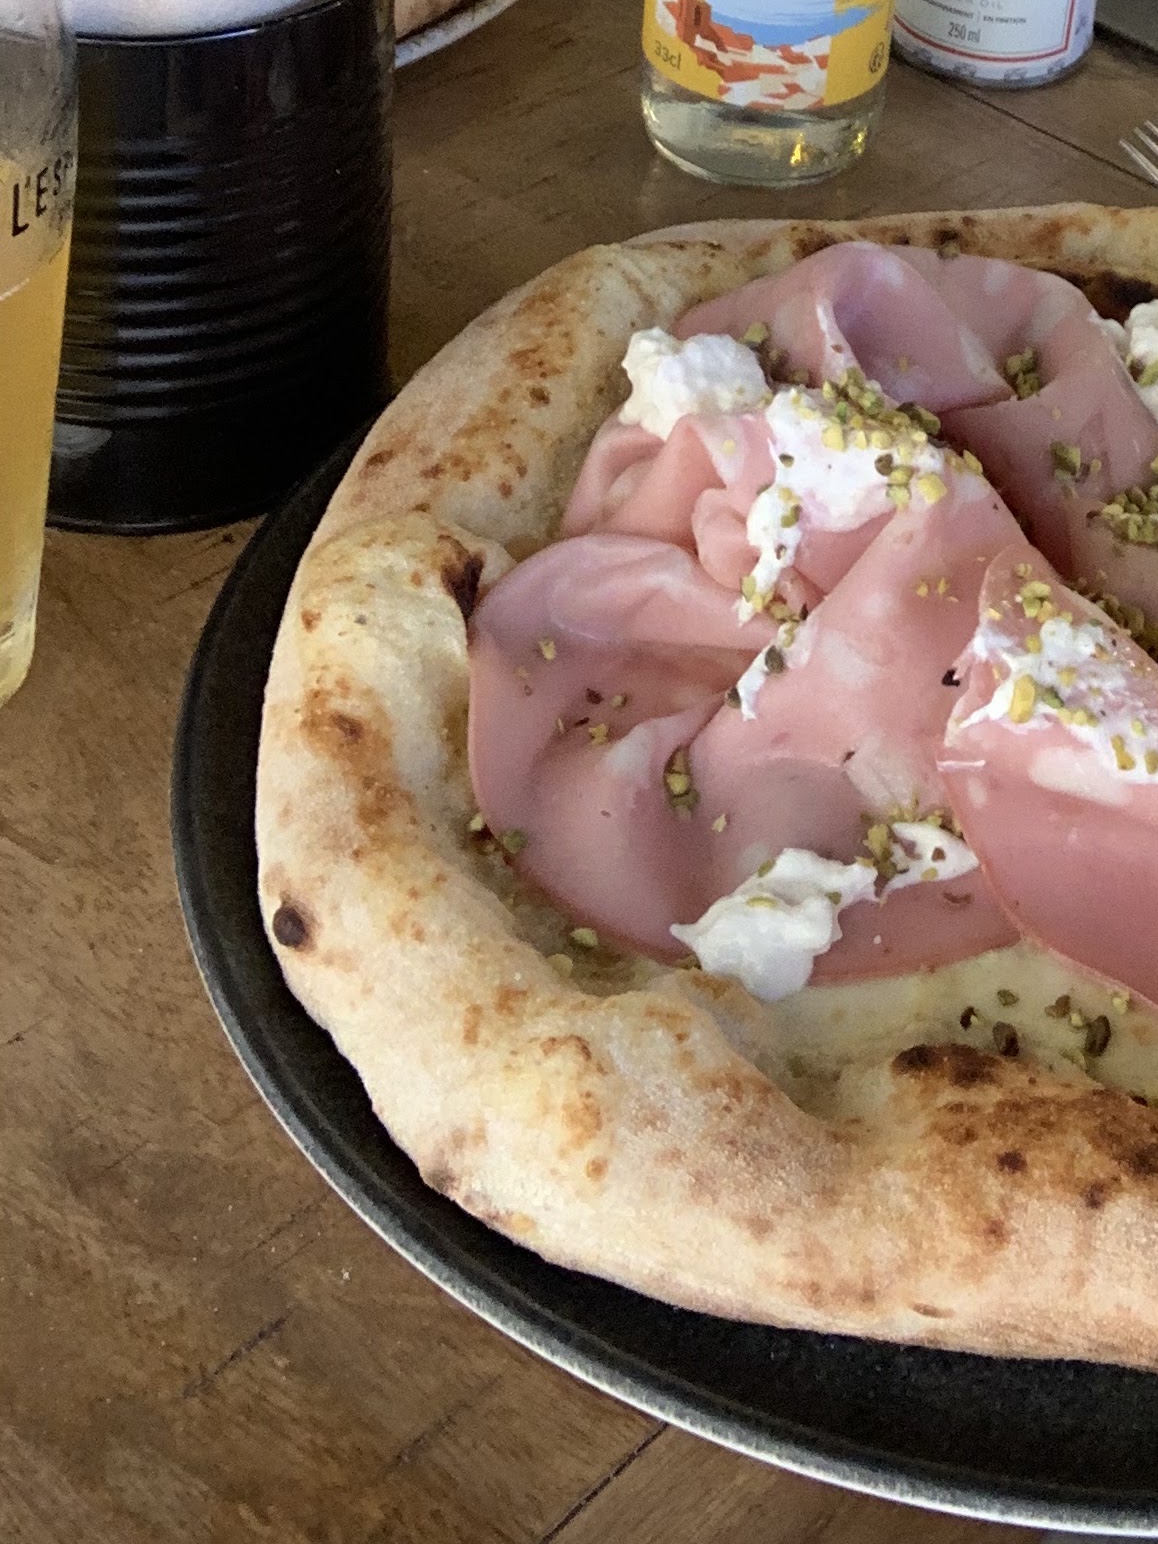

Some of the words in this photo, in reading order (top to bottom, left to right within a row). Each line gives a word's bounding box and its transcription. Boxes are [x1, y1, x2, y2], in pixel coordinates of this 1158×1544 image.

[947, 20, 967, 41] 250
[967, 28, 982, 44] ml
[653, 39, 683, 71] 33cl
